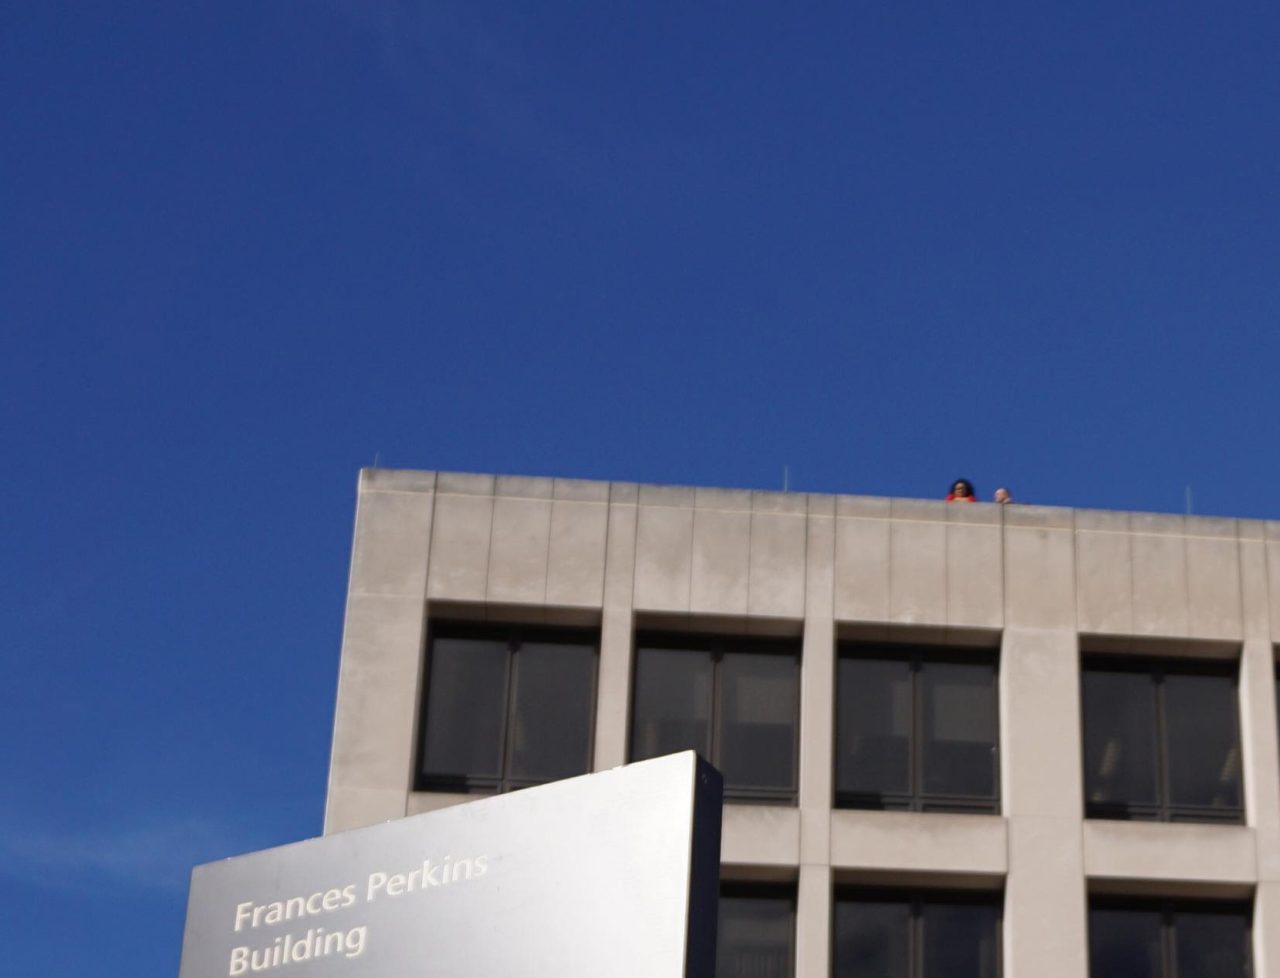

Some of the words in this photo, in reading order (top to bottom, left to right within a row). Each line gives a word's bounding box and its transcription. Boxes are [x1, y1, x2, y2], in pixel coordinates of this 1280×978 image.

[234, 884, 356, 931] Frances
[367, 855, 488, 901] Perkins
[229, 925, 367, 976] Building
